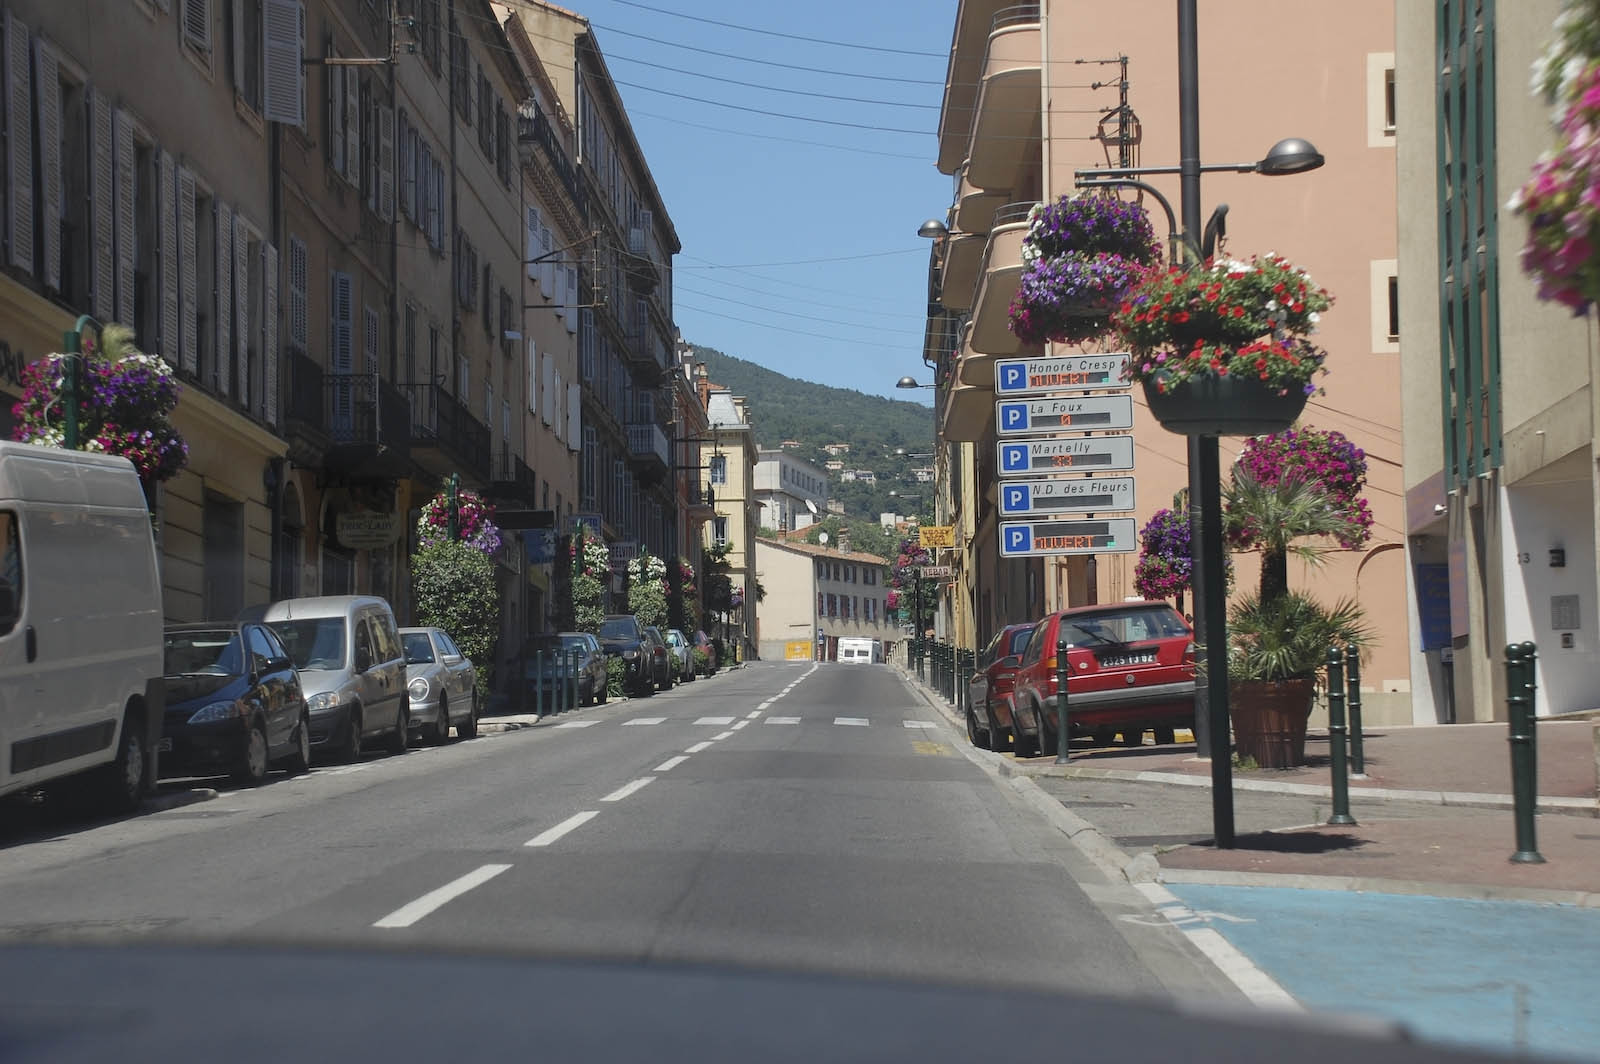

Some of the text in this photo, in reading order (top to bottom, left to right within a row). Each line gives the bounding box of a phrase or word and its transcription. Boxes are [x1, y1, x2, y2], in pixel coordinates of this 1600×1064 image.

[1029, 360, 1115, 373] Honoré Cresp
[1029, 373, 1089, 387] OUVERT
[1031, 403, 1083, 413] La Foux
[1031, 442, 1090, 454] Martelly
[1051, 455, 1073, 467] 33
[1064, 484, 1084, 494] des
[1091, 482, 1128, 493] Fleurs
[1033, 535, 1095, 549] OUVERT
